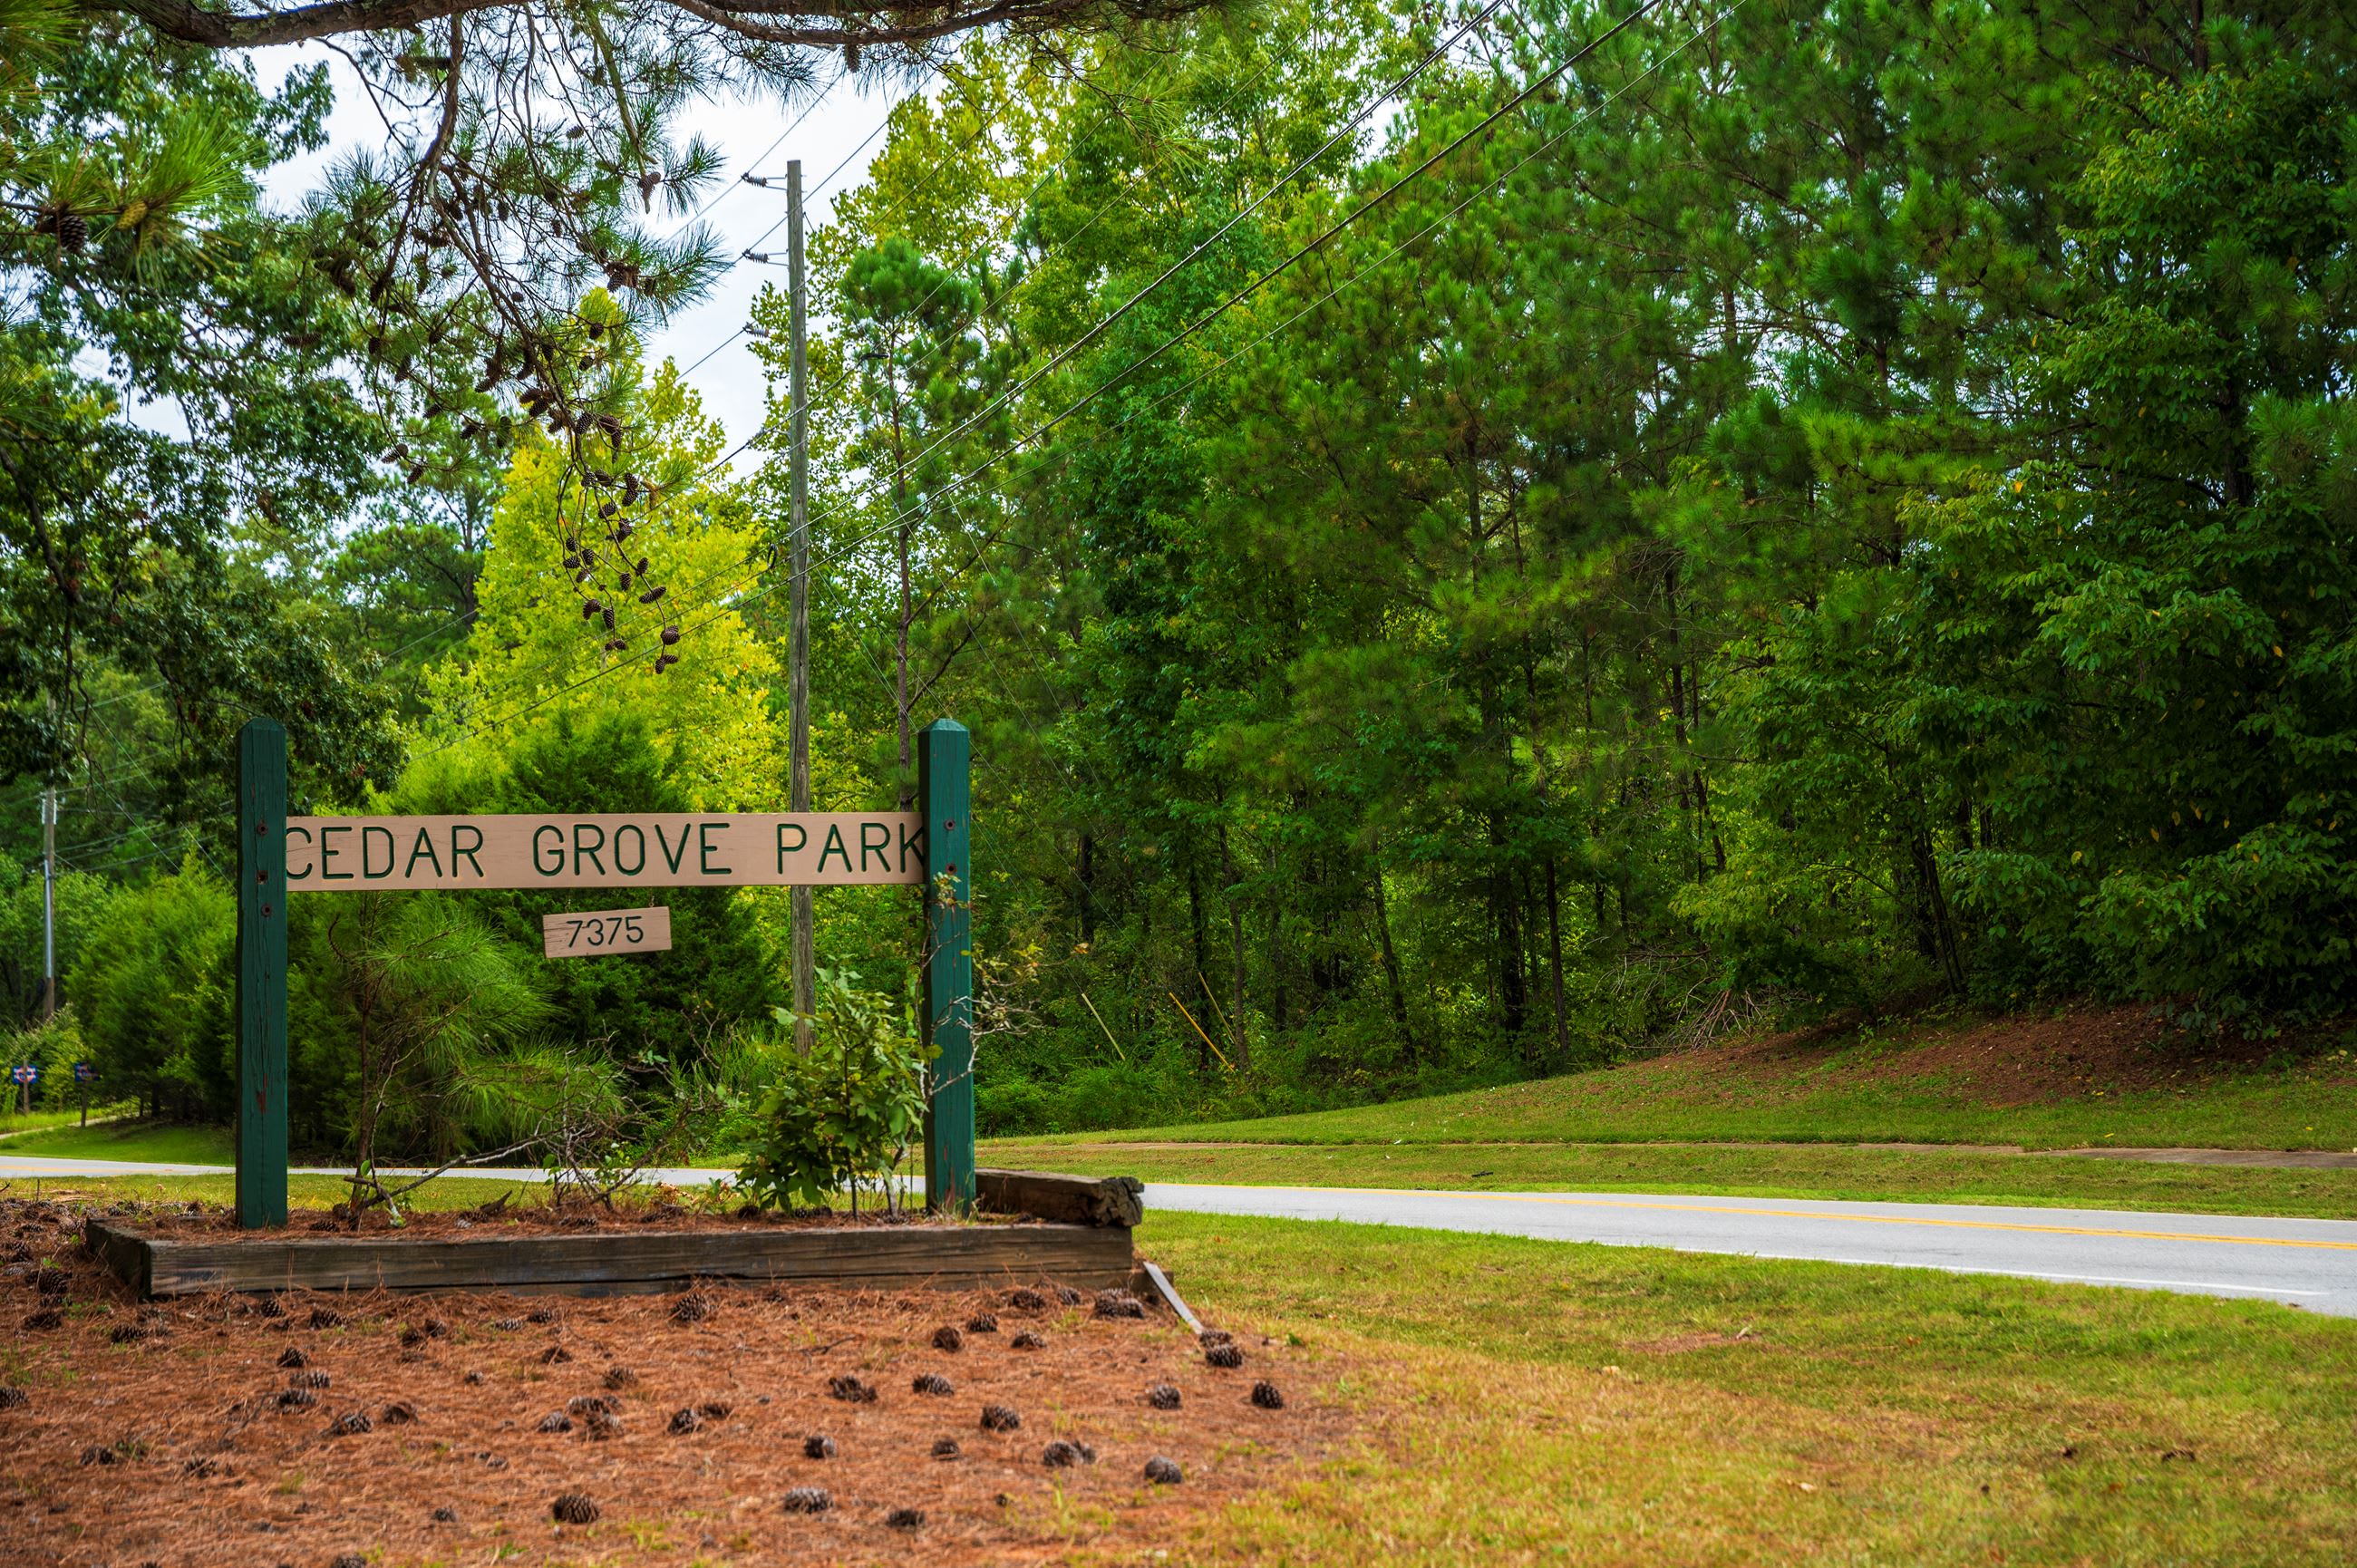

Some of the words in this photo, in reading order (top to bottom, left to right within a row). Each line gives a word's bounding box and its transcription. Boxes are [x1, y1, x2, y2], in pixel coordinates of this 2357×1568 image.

[286, 824, 485, 880] CEDAR
[532, 822, 732, 877] GROVE
[776, 822, 925, 875] PARK
[566, 915, 645, 948] 7375
